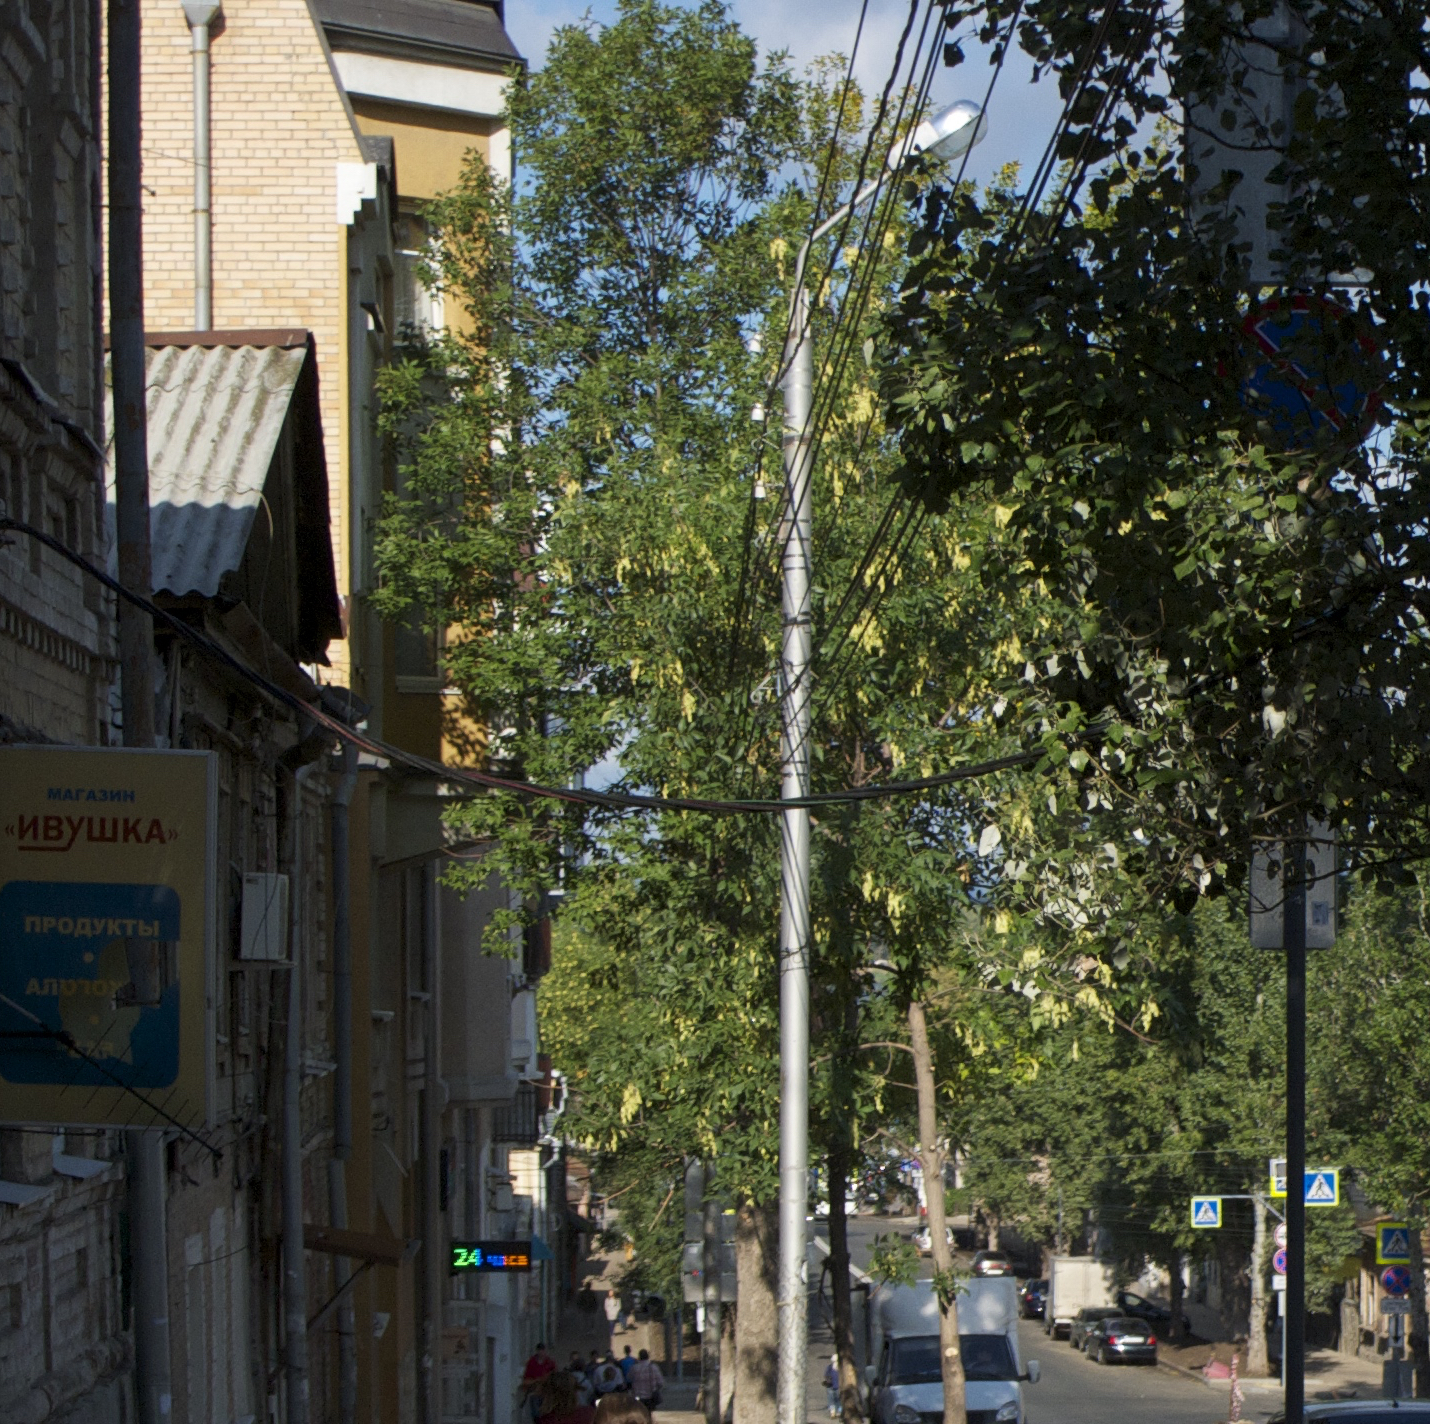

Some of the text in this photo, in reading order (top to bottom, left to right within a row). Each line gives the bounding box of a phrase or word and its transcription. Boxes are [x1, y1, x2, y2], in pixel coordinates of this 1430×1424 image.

[47, 787, 135, 803] МАГАЗИН
[4, 814, 180, 851] «ИВУШКА»
[24, 915, 160, 939] ПРОДУКТЫ
[453, 1248, 483, 1267] 24
